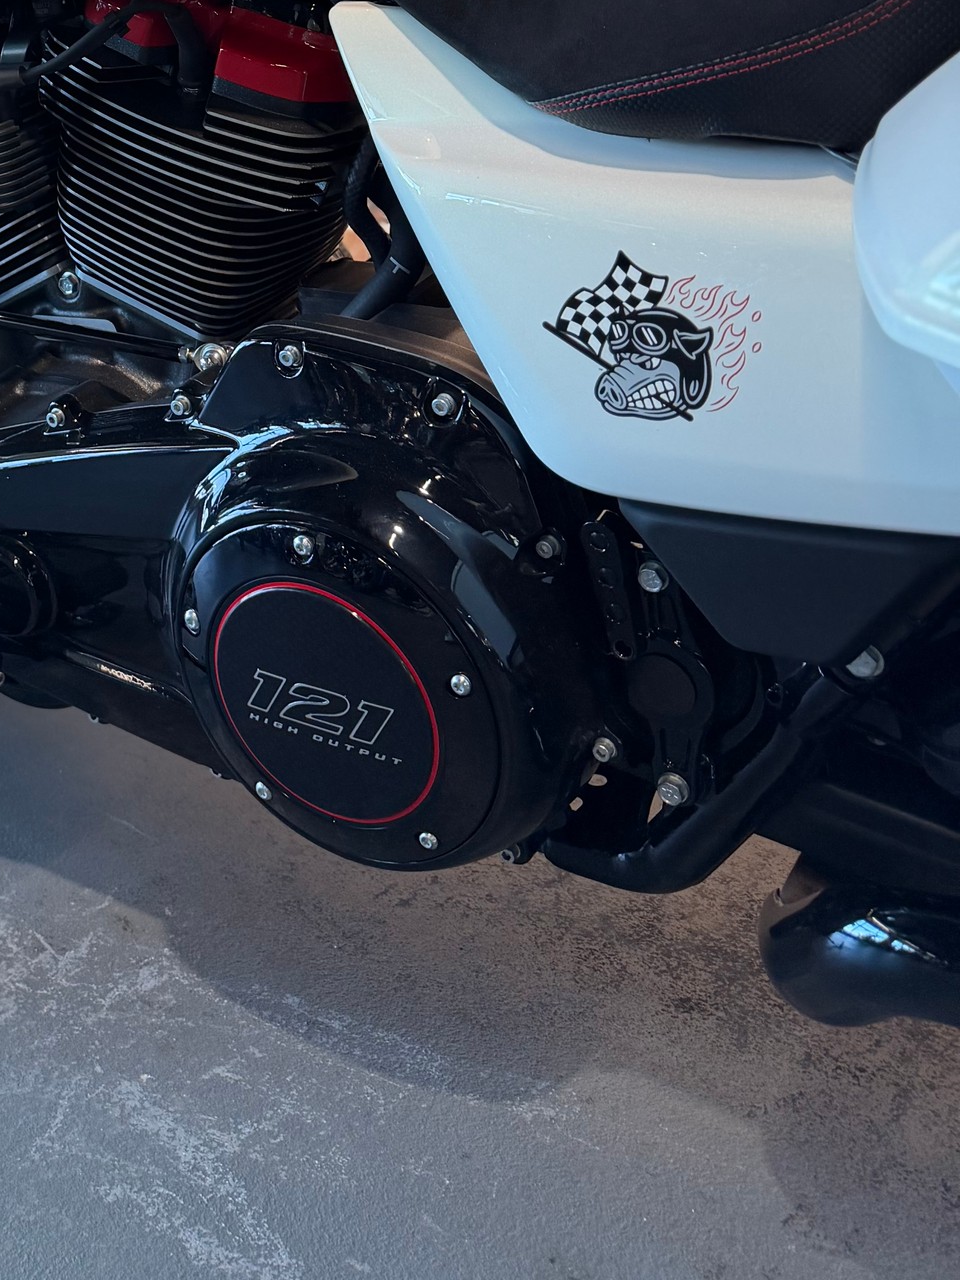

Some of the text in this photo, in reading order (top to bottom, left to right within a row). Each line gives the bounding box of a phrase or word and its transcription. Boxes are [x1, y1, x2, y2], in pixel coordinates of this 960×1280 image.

[247, 668, 395, 745] 121
[249, 712, 403, 765] HIGH OUTPUT
